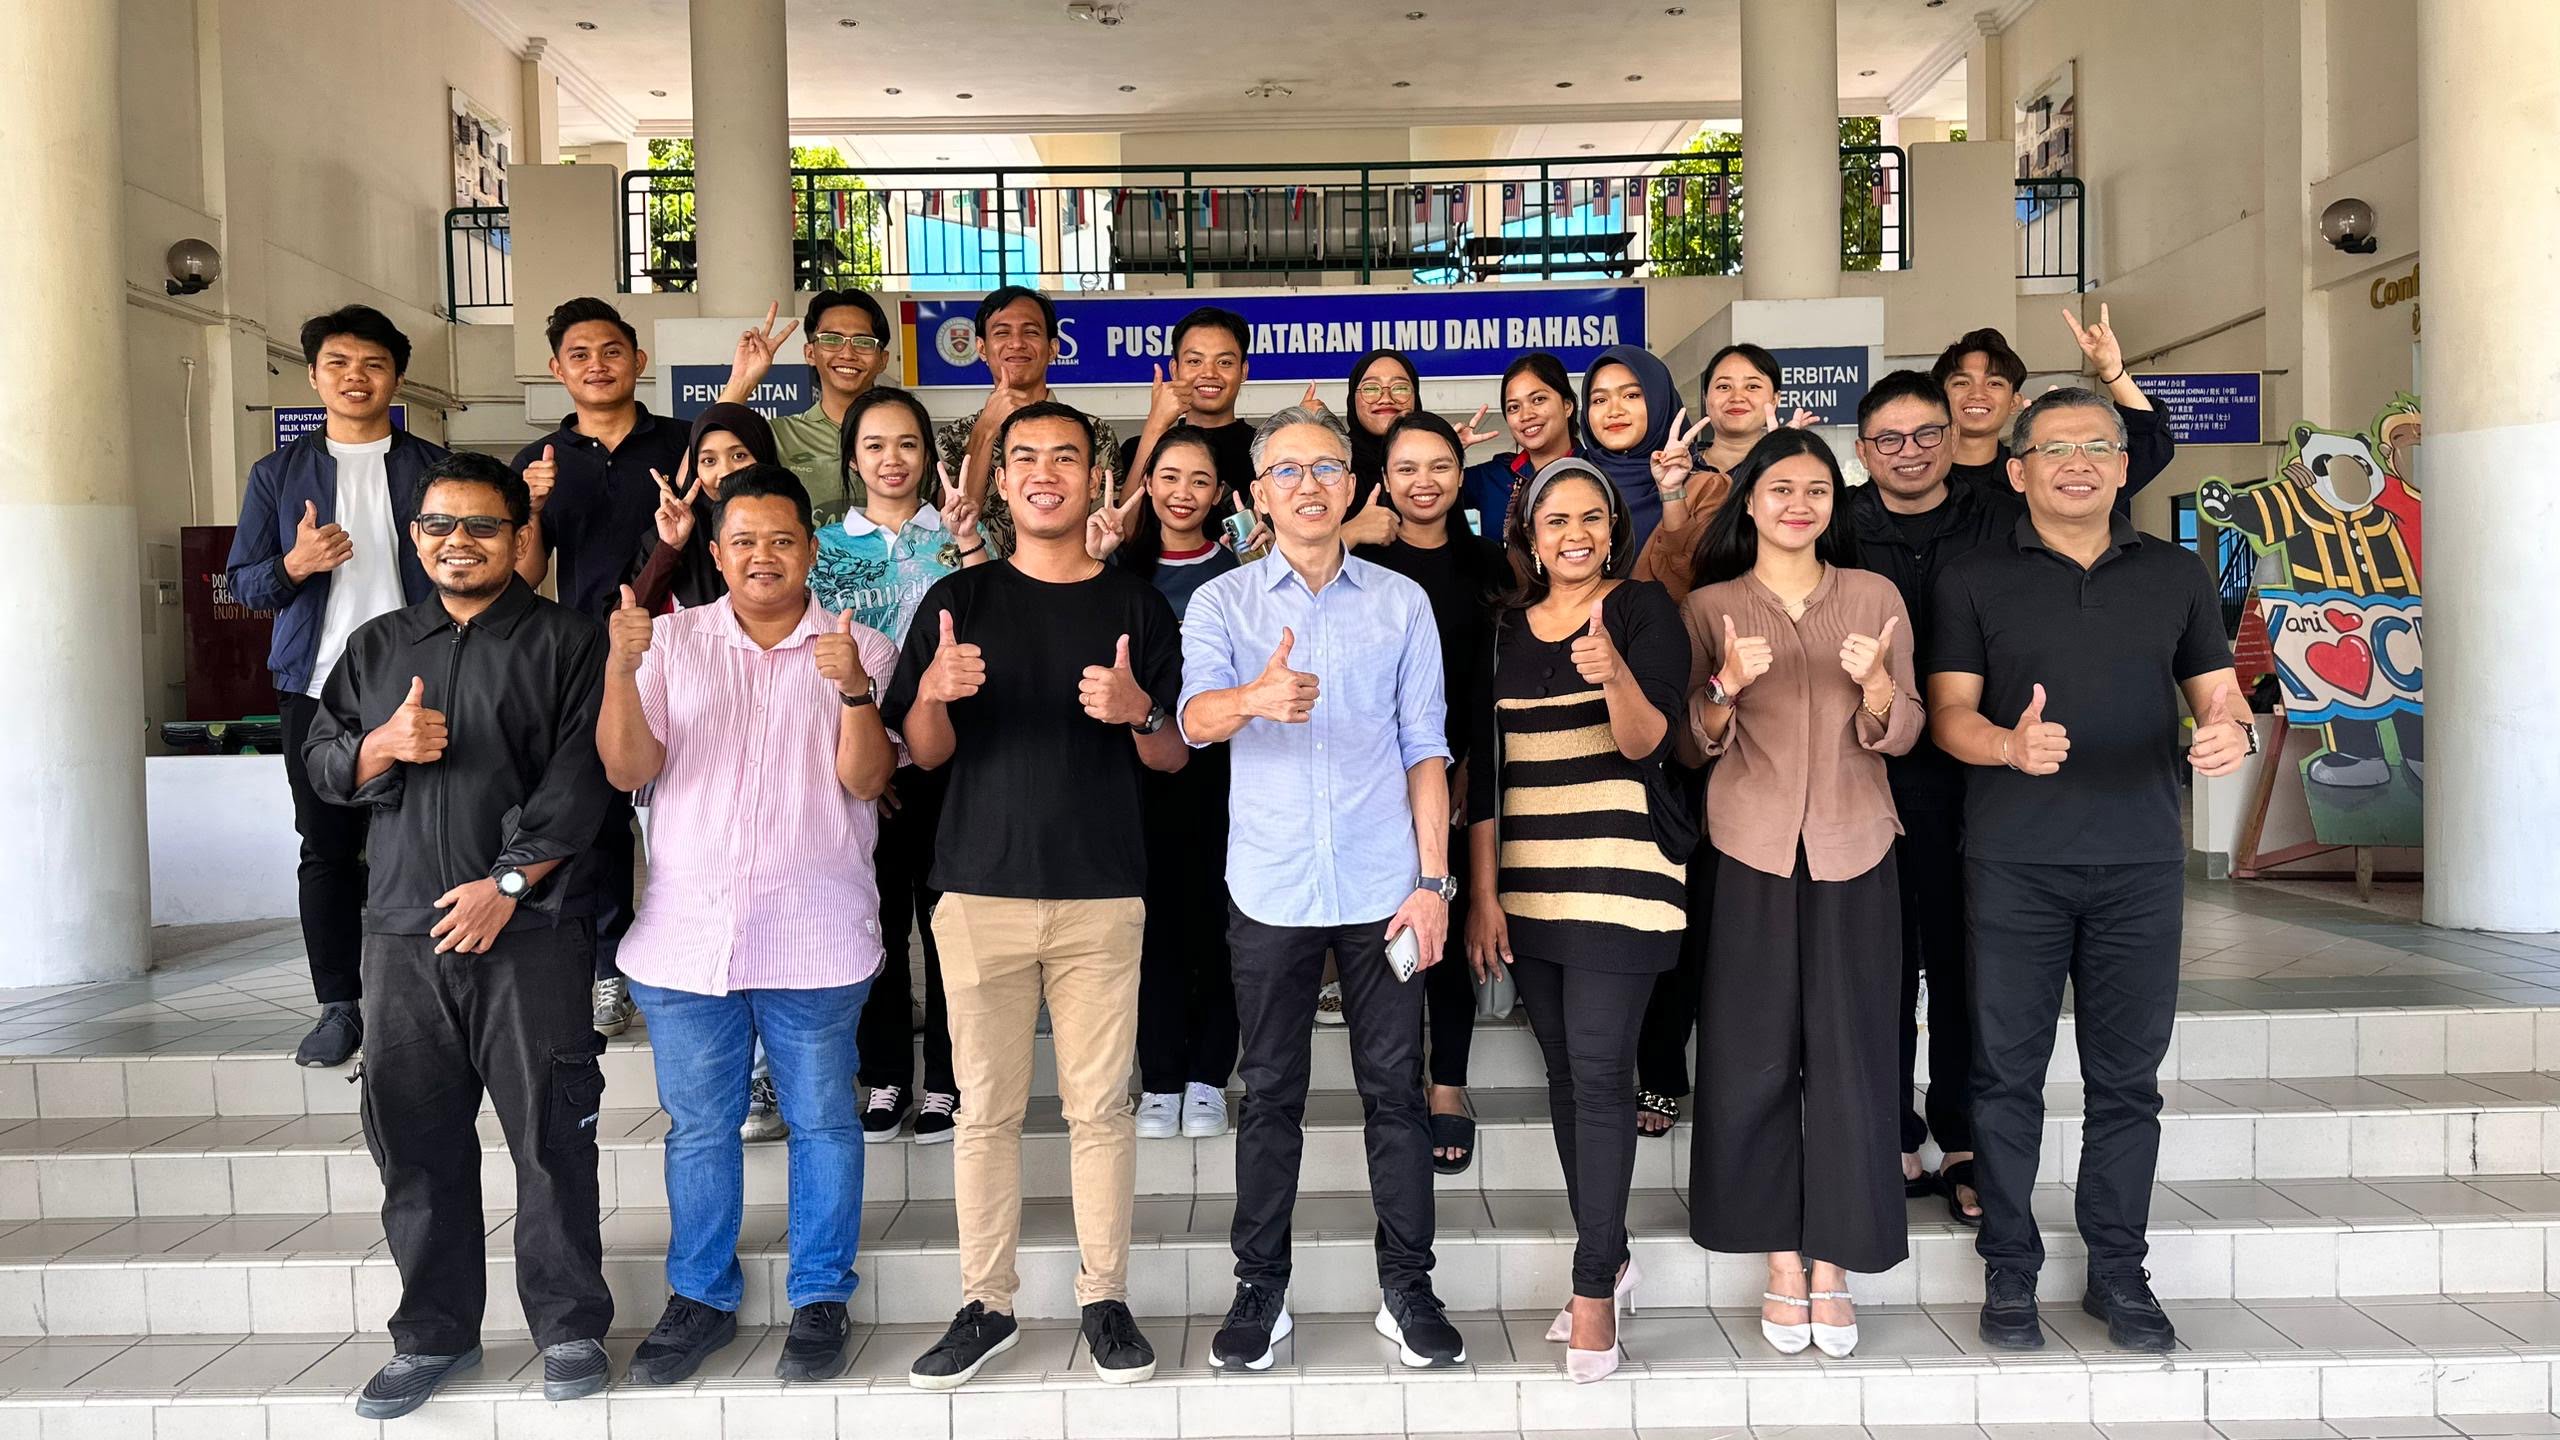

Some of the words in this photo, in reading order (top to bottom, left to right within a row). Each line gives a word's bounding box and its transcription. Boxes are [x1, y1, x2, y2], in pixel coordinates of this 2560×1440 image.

[1106, 325, 1175, 357] PUSA
[1247, 321, 1363, 354] ATARAN
[1371, 320, 1438, 352] ILMU
[1445, 318, 1503, 350] DAN
[1506, 315, 1620, 348] BAHASA
[1781, 366, 1859, 385] ERBITAN
[2157, 379, 2167, 387] AM
[683, 384, 798, 402] PENBITAN
[1777, 389, 1838, 408] ERKINI
[2157, 388, 2185, 396] PENGARAH
[279, 413, 328, 422] PERPUSTAKA
[279, 424, 300, 432] BILIK
[300, 424, 322, 432] MESY
[213, 589, 235, 604] GREA
[213, 605, 239, 621] ENJOY
